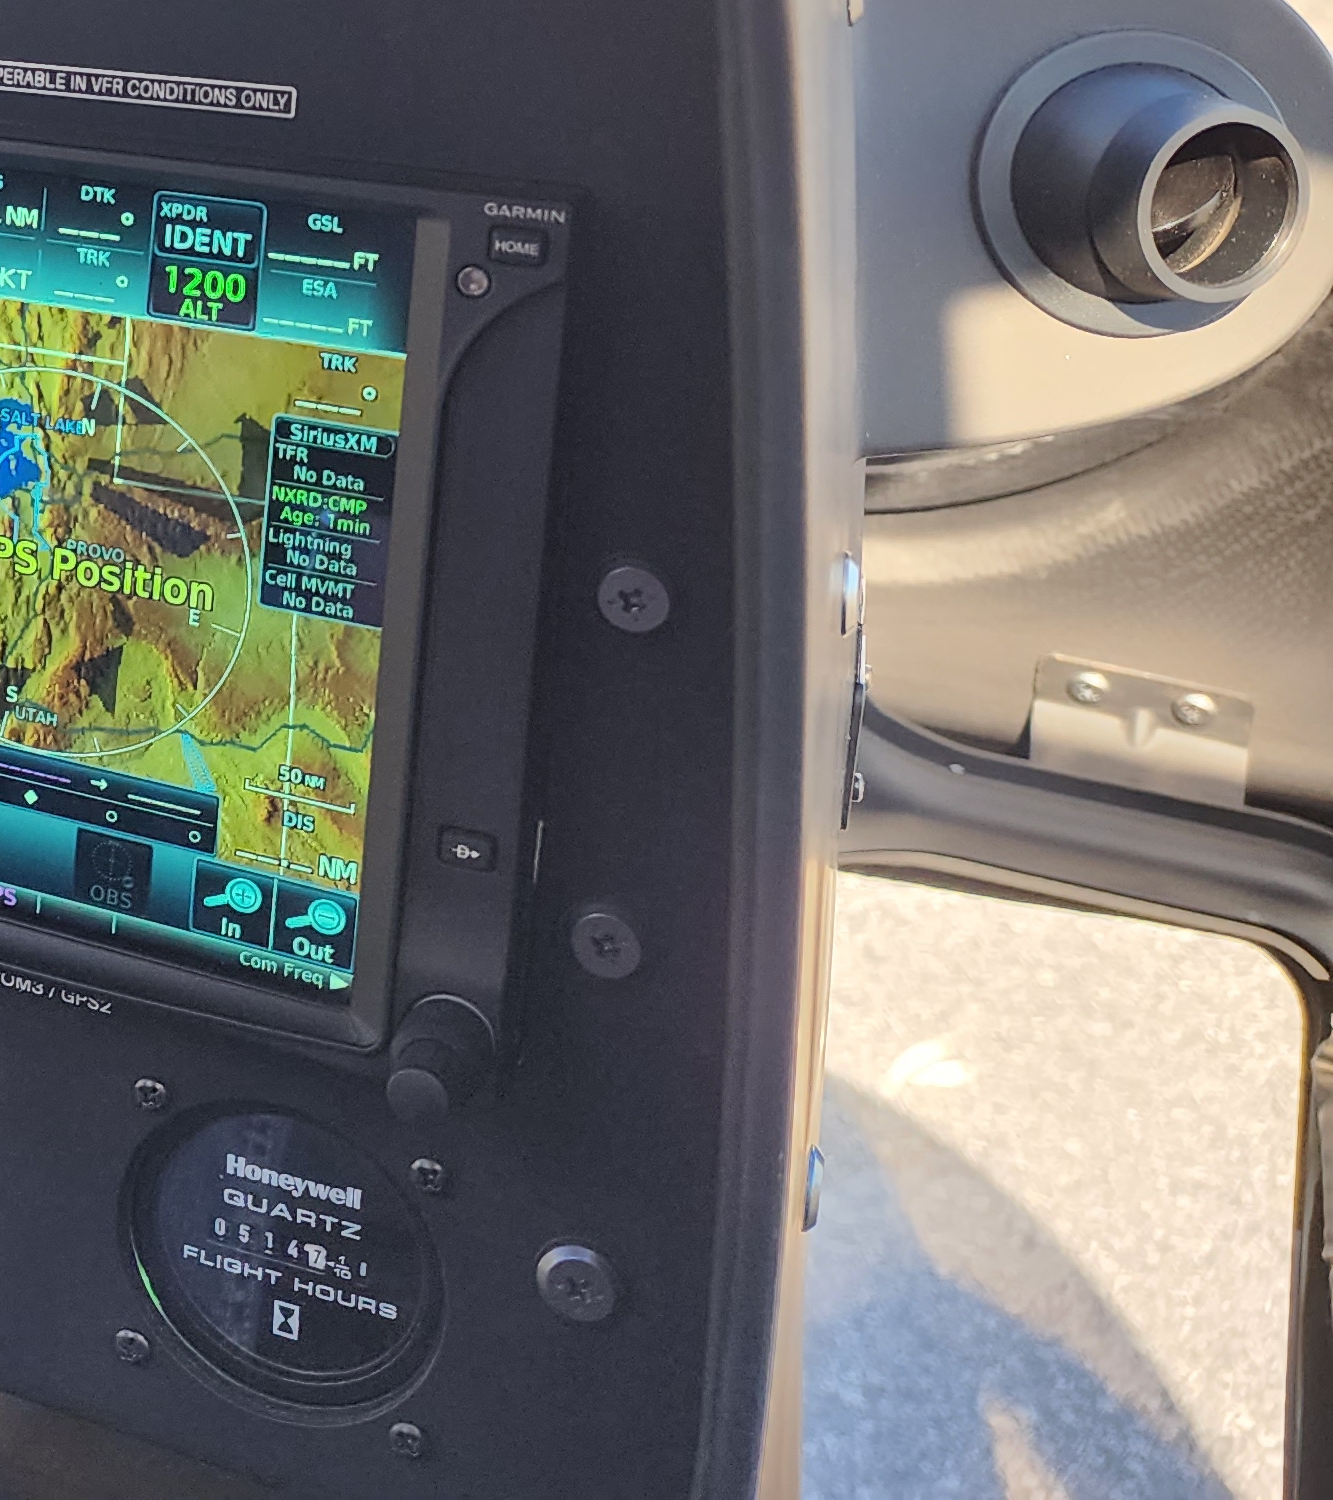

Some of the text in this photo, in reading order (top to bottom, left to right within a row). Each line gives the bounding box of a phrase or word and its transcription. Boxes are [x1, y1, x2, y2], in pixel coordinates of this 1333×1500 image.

[70, 74, 87, 91] IN
[91, 76, 123, 94] VFR
[127, 79, 236, 106] CONDITIONS
[240, 91, 289, 112] ONLY
[80, 185, 116, 205] DTK
[5, 205, 39, 229] NM
[160, 201, 208, 223] XPDR
[307, 213, 343, 235] GSL
[483, 201, 566, 224] GARMIN
[164, 223, 253, 259] IDENT
[494, 238, 540, 258] HOME
[77, 247, 111, 268] TRK
[353, 252, 379, 273] FT
[0, 266, 32, 291] KT
[165, 265, 246, 303] 1200
[302, 278, 338, 299] ESA
[178, 300, 224, 322] ALT
[348, 318, 374, 338] FT
[320, 353, 358, 374] TRK
[290, 423, 378, 454] SiriusXM
[276, 443, 308, 463] TFR
[293, 464, 364, 492] No Data
[269, 528, 353, 560] Lightning
[286, 549, 357, 577] No Data
[52, 547, 215, 612] Position
[265, 569, 356, 600] Cell MVMT
[283, 591, 354, 619] No Data
[14, 706, 59, 727] UTAH
[283, 811, 315, 833] DIS
[318, 854, 358, 885] NM
[221, 916, 243, 939] In
[292, 936, 336, 965] Out
[239, 950, 325, 990] Com Freq
[226, 1153, 363, 1210] Honeywell
[223, 1188, 362, 1241] QUARTZ
[183, 1244, 397, 1320] FLIGHT HOURS
